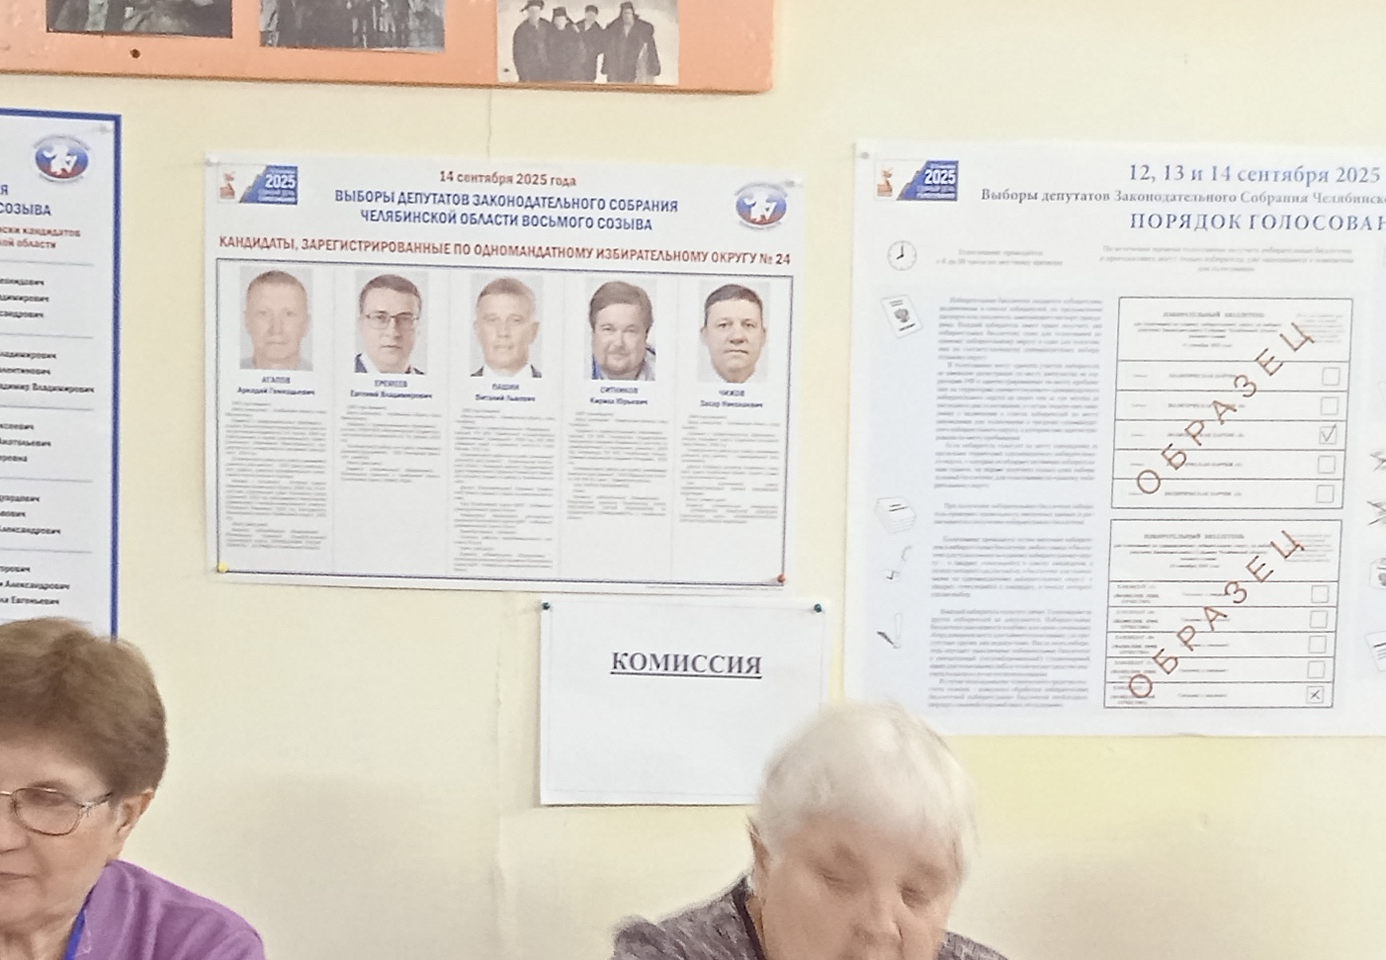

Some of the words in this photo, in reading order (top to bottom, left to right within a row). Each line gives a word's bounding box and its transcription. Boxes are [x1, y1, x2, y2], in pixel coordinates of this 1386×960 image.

[265, 173, 296, 189] 2025
[439, 170, 453, 182] 14
[456, 171, 513, 187] сентября
[516, 173, 547, 186] 2025
[550, 176, 577, 188] года
[924, 168, 956, 185] 2025
[1129, 164, 1155, 183] 12,
[1164, 164, 1184, 181] 13
[1190, 169, 1202, 181] и
[1211, 165, 1230, 182] 14
[1237, 165, 1329, 187] сентября
[1336, 167, 1380, 184] 2025
[335, 190, 395, 203] ВЫБОРЫ
[398, 191, 469, 206] ДЕПУТАТОВ
[473, 194, 605, 211] ЗАКОНОДАТЕЛЬНОГО
[609, 198, 678, 213] СОБРАНИЯ
[981, 188, 1038, 204] Выборы
[1041, 190, 1110, 205] депутатов
[1114, 190, 1237, 205] Законодательного
[1240, 191, 1308, 206] Собрания
[361, 208, 457, 224] ЧЕЛЯБИНСКОЙ
[460, 211, 518, 227] ОБЛАСТИ
[522, 215, 593, 229] ВОСЬМОГО
[597, 217, 653, 231] СОЗЫВА
[1130, 212, 1240, 231] ПОРЯДОК
[17, 238, 56, 249] области
[219, 235, 298, 251] КАНДИДАТЫ,
[301, 238, 451, 255] ЗАРЕГИСТРИРОВАННЫЕ
[454, 243, 471, 255] ПО
[474, 243, 593, 260] ОДНОМАНДАТНОМУ
[596, 248, 709, 263] ИЗБИРАТЕЛЬНОМУ
[712, 250, 757, 264] ОКРУГУ
[759, 251, 773, 264] №
[775, 253, 790, 265] 24
[1136, 322, 1315, 494] ОБРАЗЕЦ
[1128, 530, 1305, 698] ОБРАЗЕЦ
[612, 652, 762, 676] КОМИССИЯ
